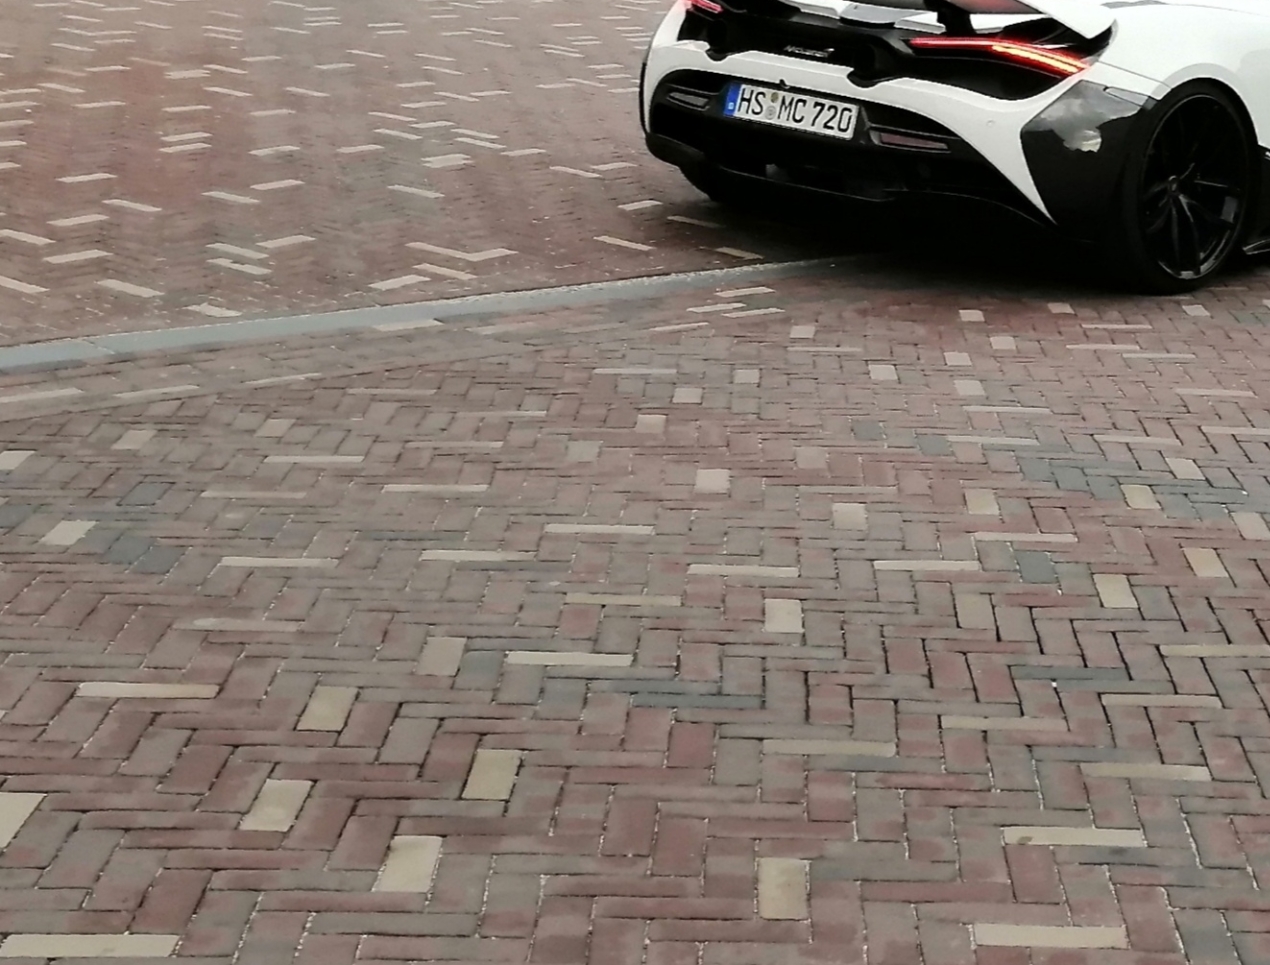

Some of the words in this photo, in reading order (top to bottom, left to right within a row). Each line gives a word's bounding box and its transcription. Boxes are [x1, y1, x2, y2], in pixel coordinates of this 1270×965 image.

[738, 88, 766, 116] HS
[777, 96, 807, 124] MC
[811, 101, 852, 133] 720
